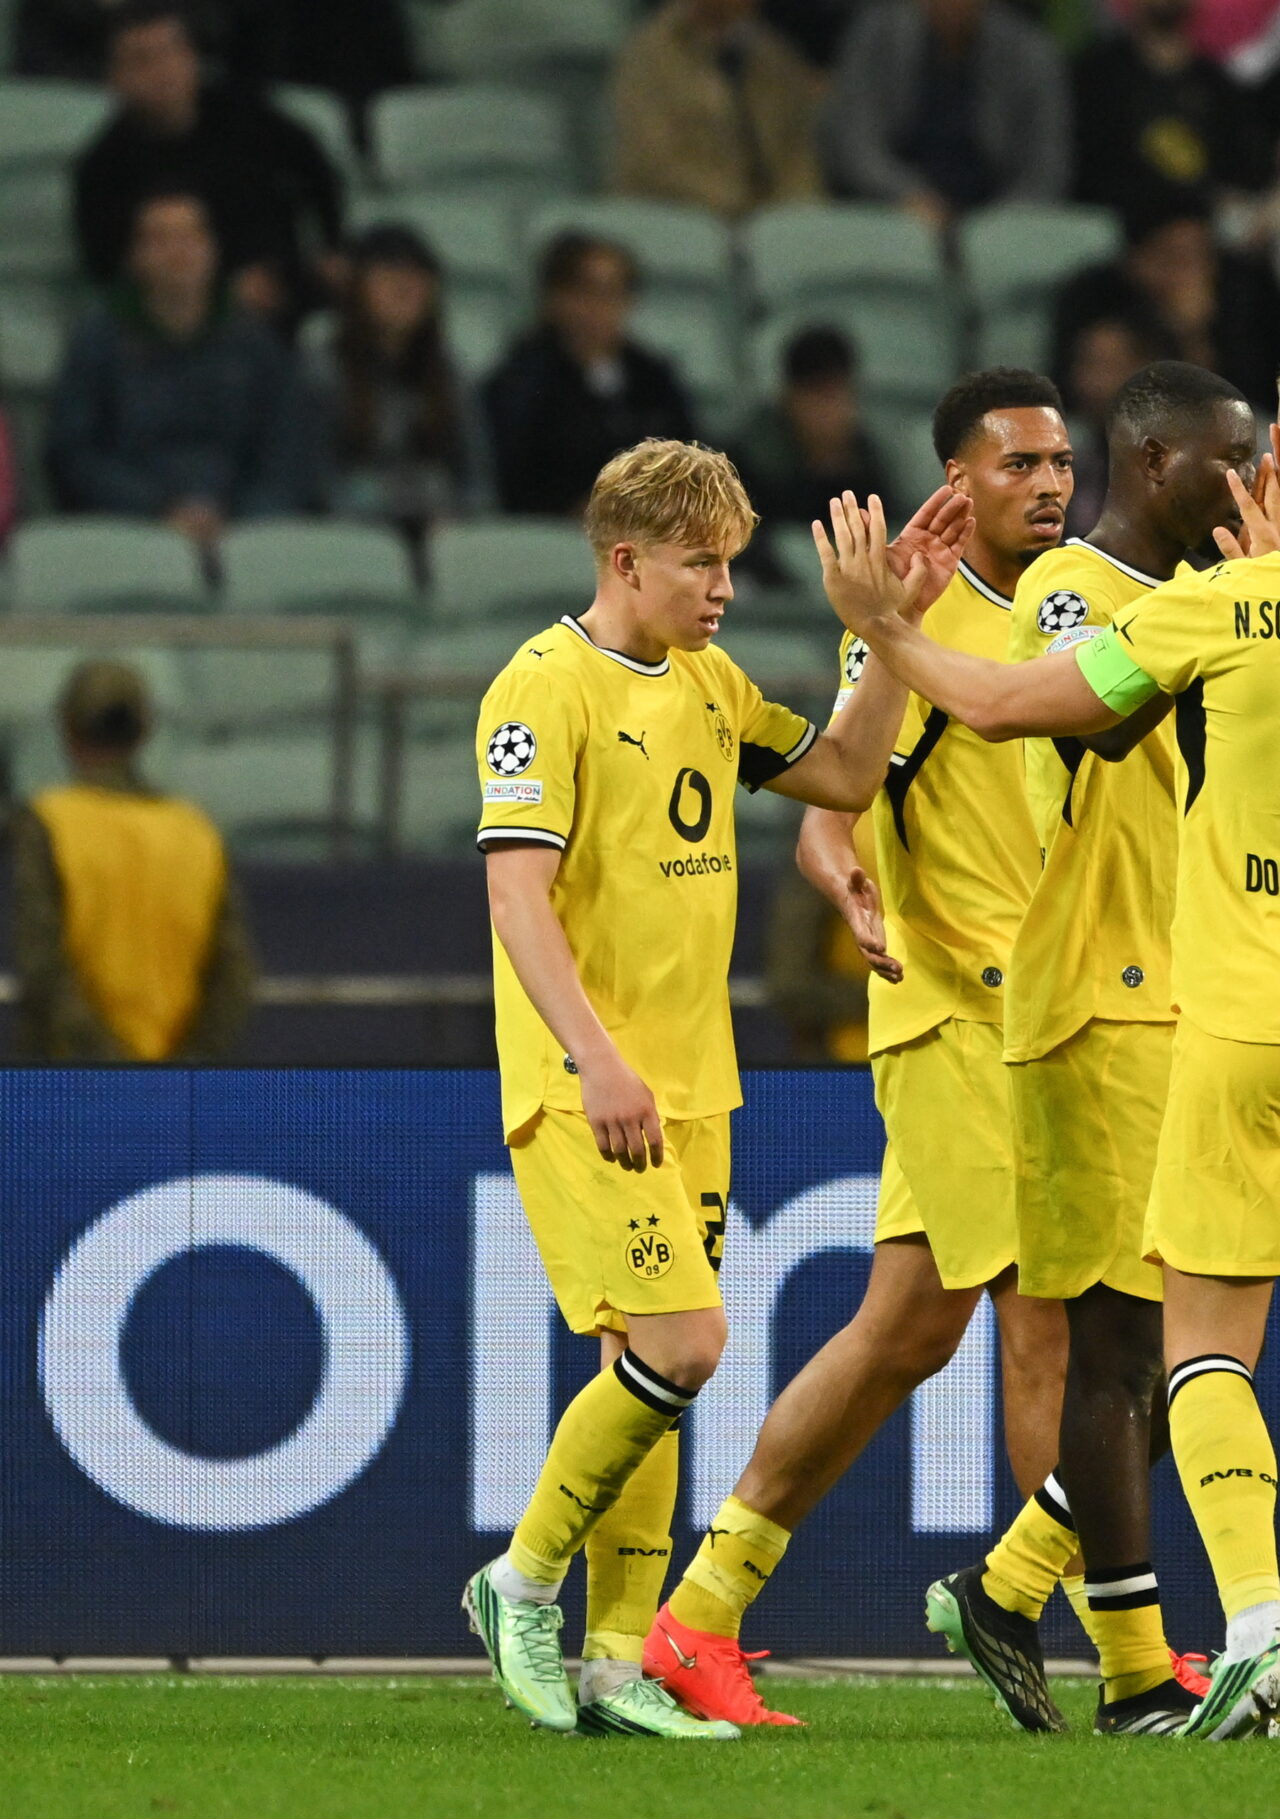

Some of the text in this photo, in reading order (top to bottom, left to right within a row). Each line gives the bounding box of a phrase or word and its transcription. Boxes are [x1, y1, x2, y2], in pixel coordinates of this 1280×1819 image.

[486, 785, 541, 796] UNDATION
[659, 853, 732, 878] vodafoe
[631, 1235, 670, 1268] BVB
[645, 1264, 660, 1276] 09
[1199, 1468, 1253, 1488] BVB
[617, 1547, 669, 1557] BVB
